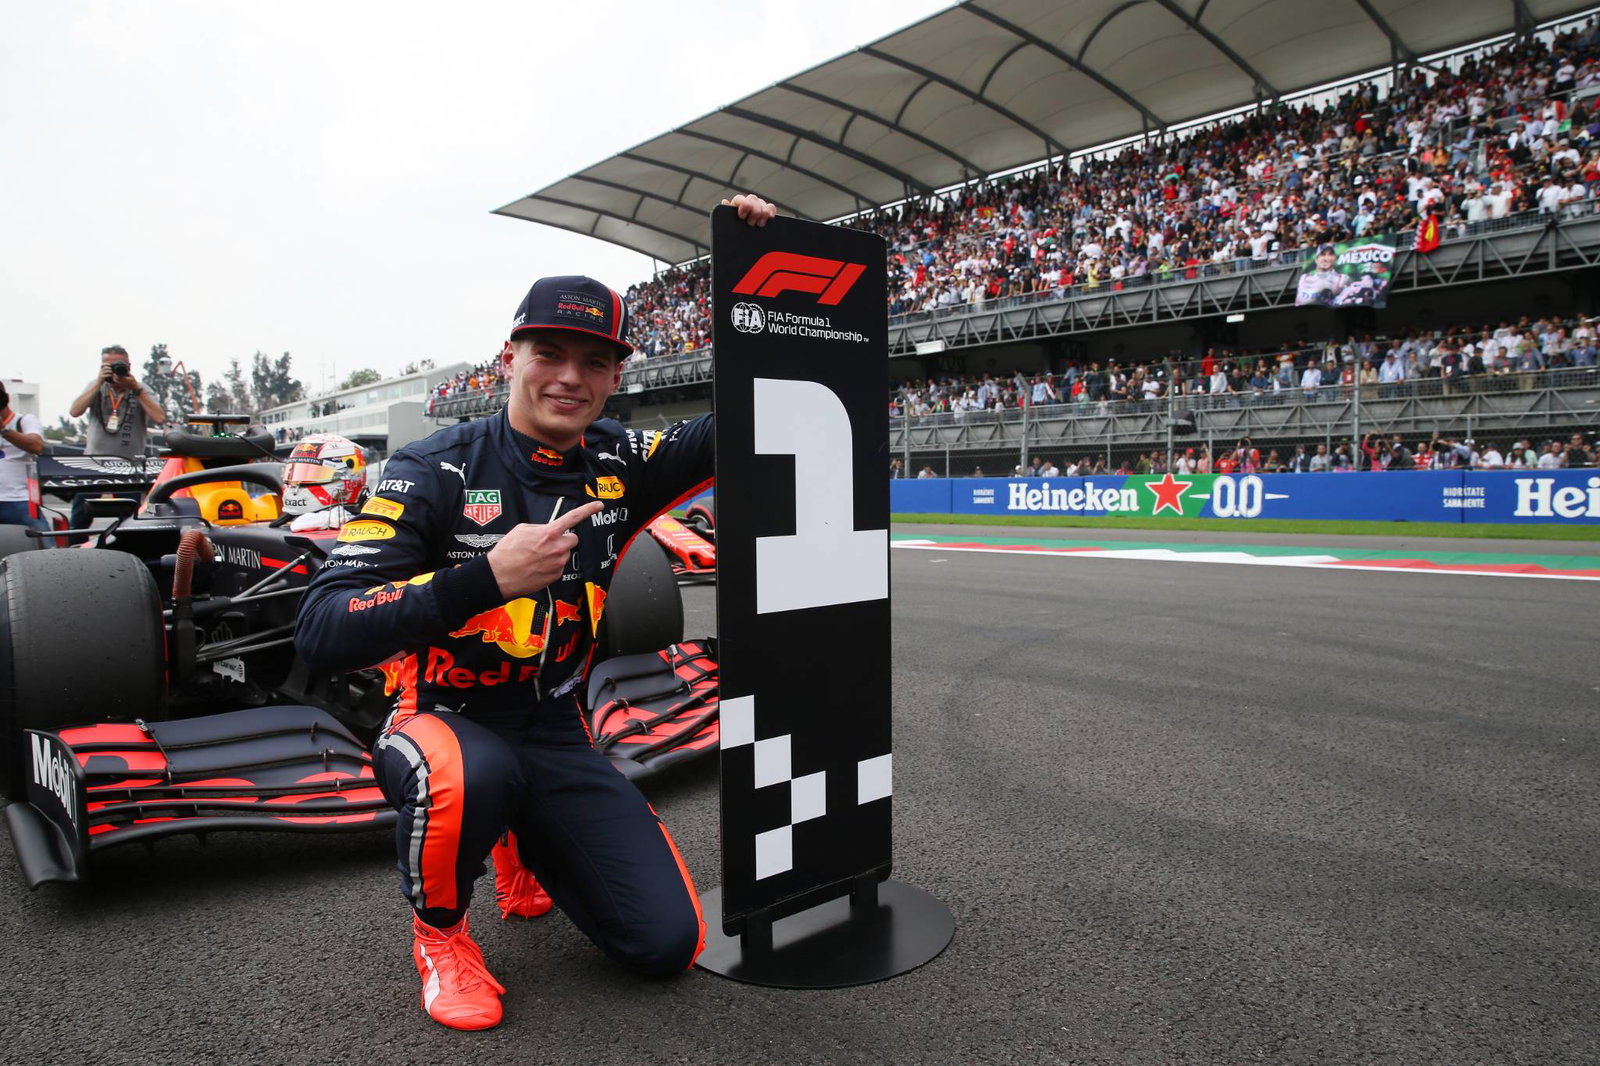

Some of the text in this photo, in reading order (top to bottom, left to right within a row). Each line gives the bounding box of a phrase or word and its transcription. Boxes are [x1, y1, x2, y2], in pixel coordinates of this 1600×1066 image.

[768, 311, 831, 327] FIA Formula 1
[768, 322, 797, 335] World
[799, 326, 862, 343] Championship
[377, 480, 415, 493] AT&T
[754, 378, 888, 614] 1
[1007, 482, 1140, 511] Heineken
[1213, 475, 1263, 518] 0.0
[468, 493, 497, 503] TAG
[465, 505, 499, 522] HEUER
[348, 526, 388, 537] RAUCH
[229, 546, 261, 569] MARTIN
[446, 551, 475, 559] ASTON
[348, 588, 404, 613] Red Bull
[424, 646, 512, 689] Red
[31, 732, 72, 820] Mobil
